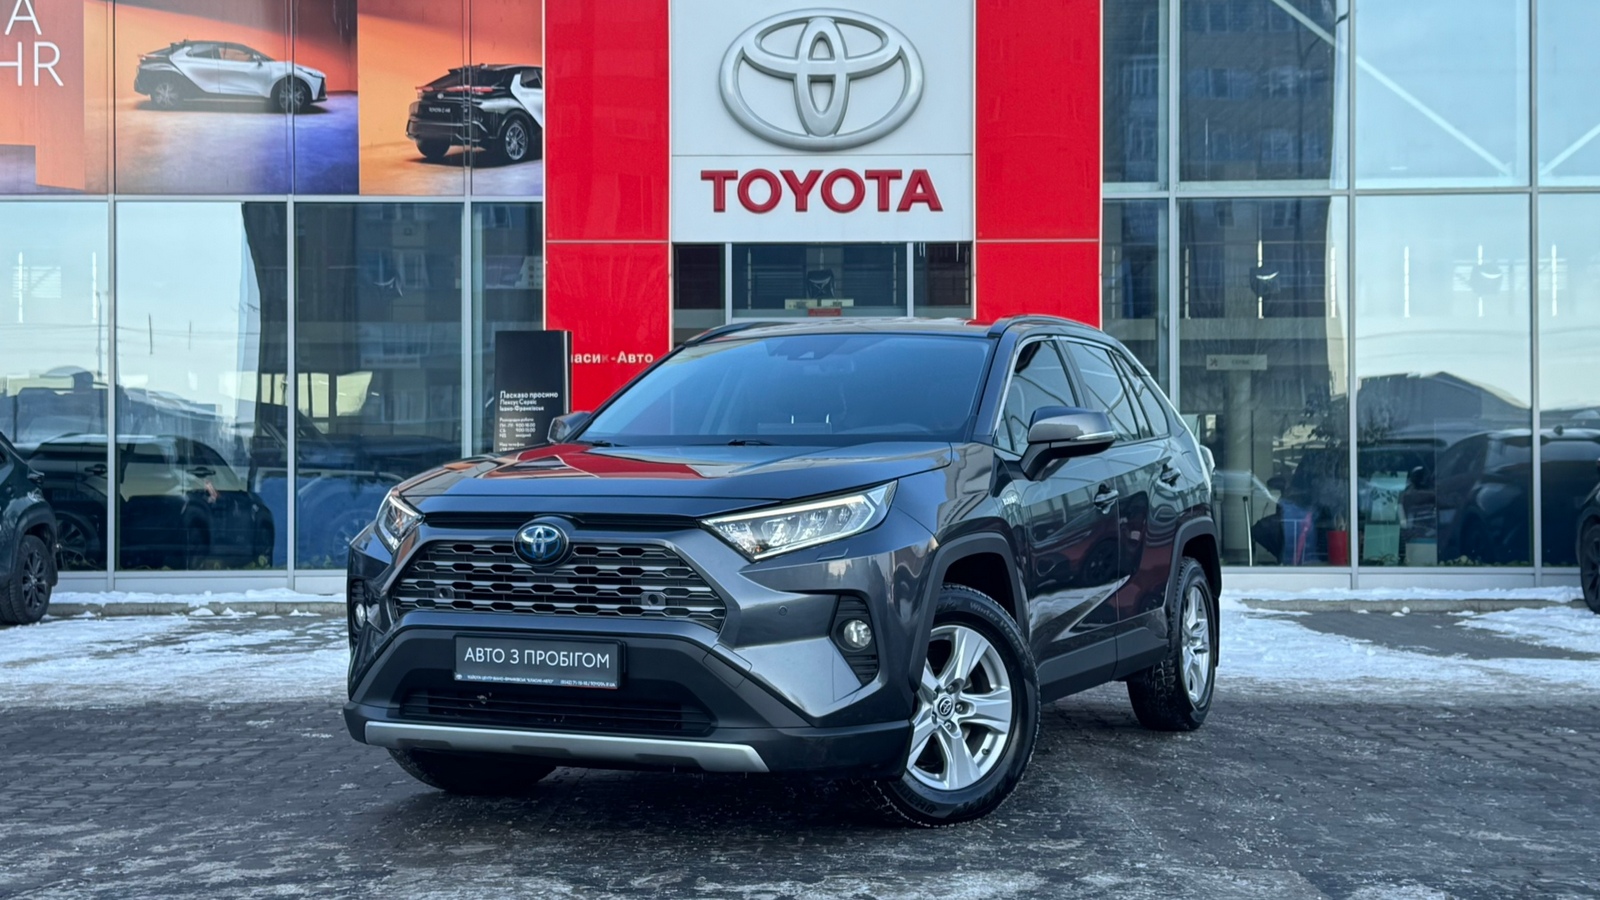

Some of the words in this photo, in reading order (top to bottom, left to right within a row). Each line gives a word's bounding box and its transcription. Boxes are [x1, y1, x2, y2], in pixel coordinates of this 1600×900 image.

[701, 168, 943, 214] TOYOTA
[529, 391, 559, 399] просимо
[464, 647, 505, 663] АВТО
[509, 649, 519, 665] З
[524, 649, 610, 669] ПРОБІГОМ
